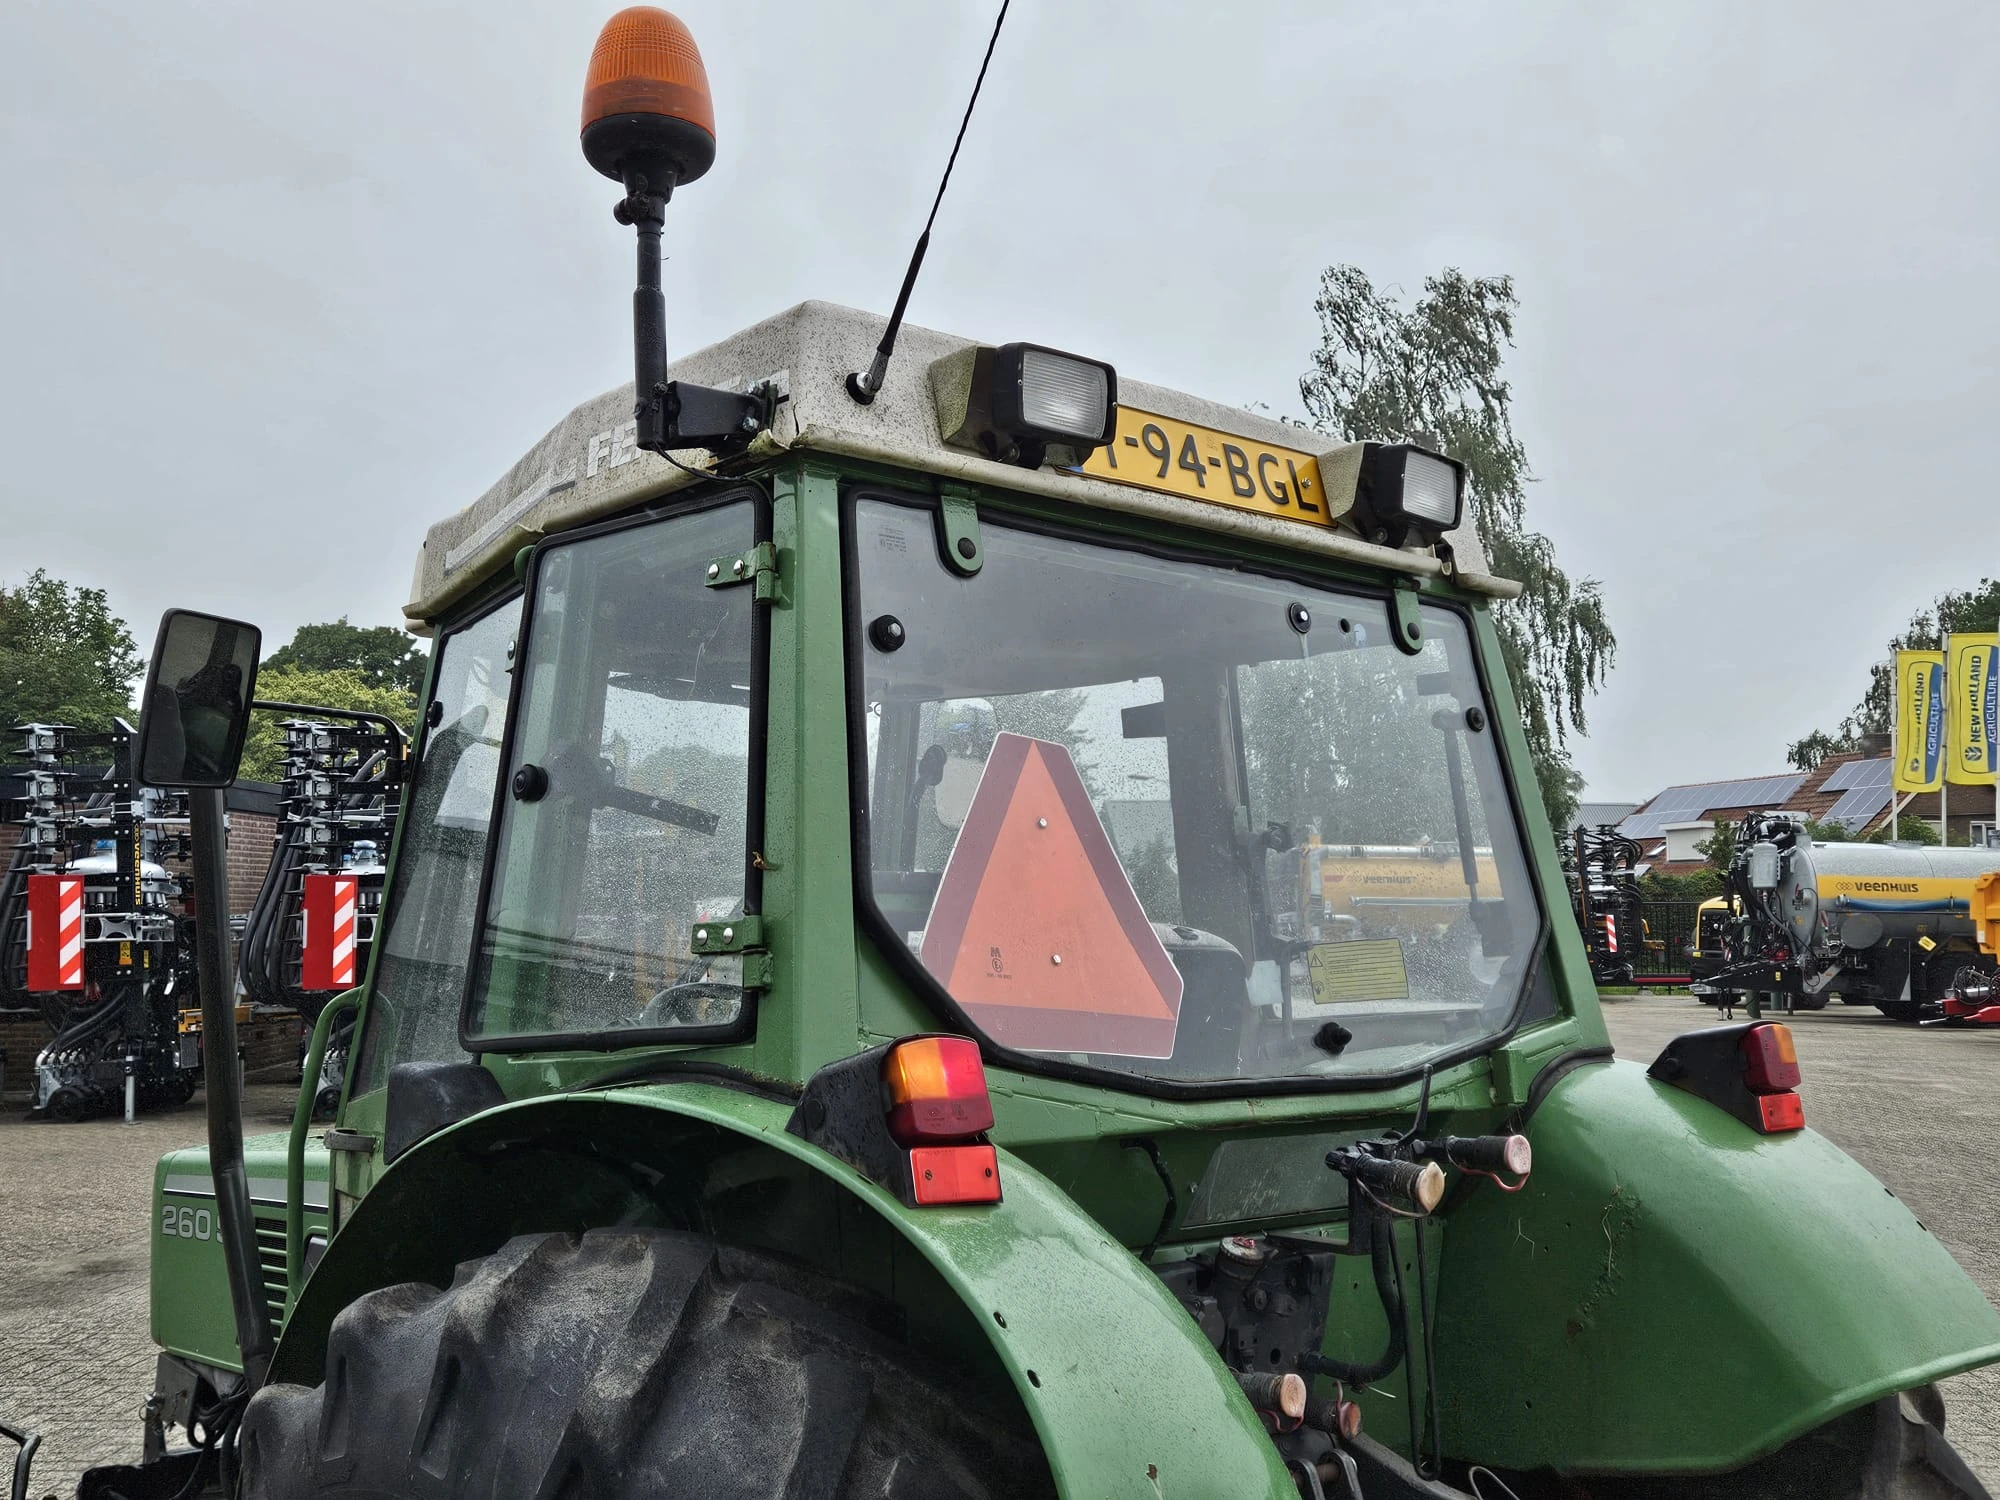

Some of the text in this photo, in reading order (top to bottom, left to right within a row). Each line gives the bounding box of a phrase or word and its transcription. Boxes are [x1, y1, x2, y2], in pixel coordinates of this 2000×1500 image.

[1969, 655, 1981, 743] NEW HOLLAND
[1986, 675, 1998, 744] AGRICULTURE
[162, 1204, 211, 1241] 260
